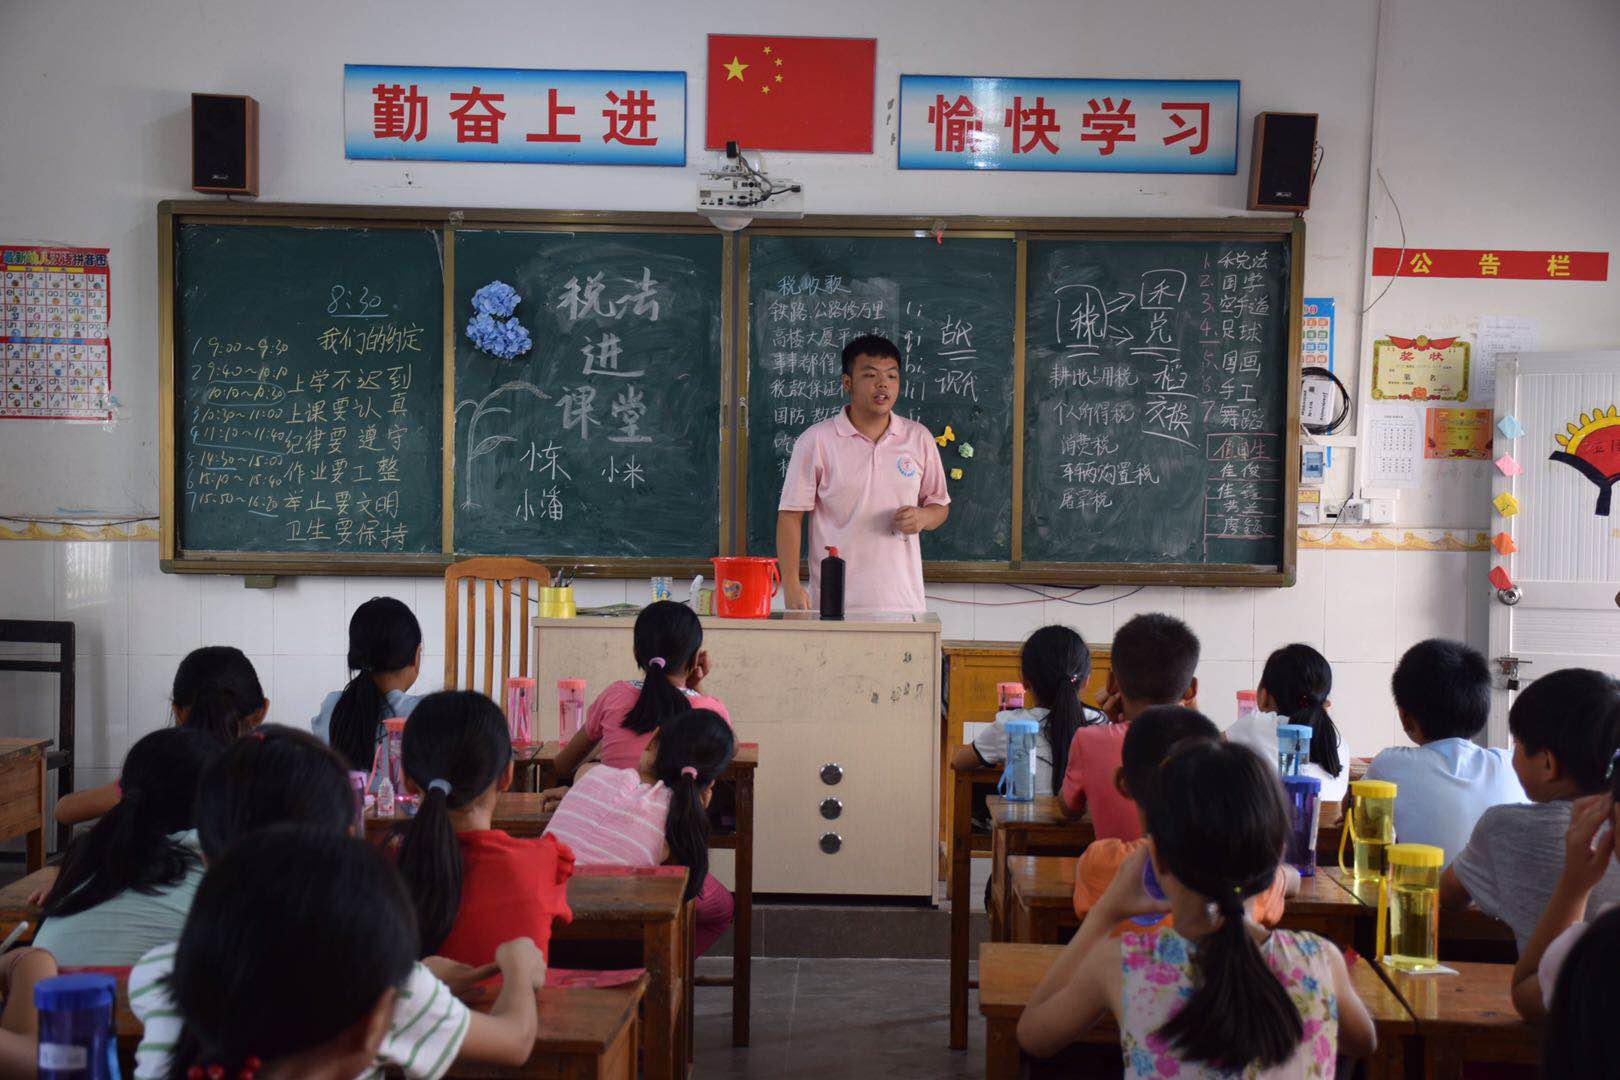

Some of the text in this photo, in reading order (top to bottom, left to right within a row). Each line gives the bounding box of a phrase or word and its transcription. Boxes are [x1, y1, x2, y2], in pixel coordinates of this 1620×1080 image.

[372, 83, 659, 147] 勤奋上进
[928, 94, 1211, 156] 愉快学习
[1217, 249, 1271, 271] 税法
[1410, 252, 1570, 277] 公告栏
[556, 266, 660, 321] 税法
[1148, 278, 1176, 305] 禾
[1223, 273, 1266, 293] 国学
[327, 284, 382, 316] 8:30
[1219, 294, 1271, 318] 空手道
[1070, 291, 1105, 348] 税
[1223, 319, 1262, 343] 足球
[318, 322, 424, 355] 我们的约定
[580, 332, 645, 377] 进
[1222, 349, 1261, 377] 国画
[1399, 351, 1444, 362] 奖状
[288, 364, 412, 392] 上学不迟到
[934, 369, 979, 403] 现代
[1219, 377, 1257, 402] 手工
[286, 393, 408, 425] 上课要认真
[554, 383, 653, 442] 课堂
[1053, 400, 1135, 426] 个人所得税
[1144, 394, 1193, 439] 交换
[284, 426, 408, 455] 纪律要遵守
[1061, 432, 1120, 457] 消费税
[284, 456, 400, 485] 作业要工整
[601, 454, 645, 489] 小米
[284, 488, 400, 518] 举止要文明
[286, 517, 408, 549] 卫生要保持
